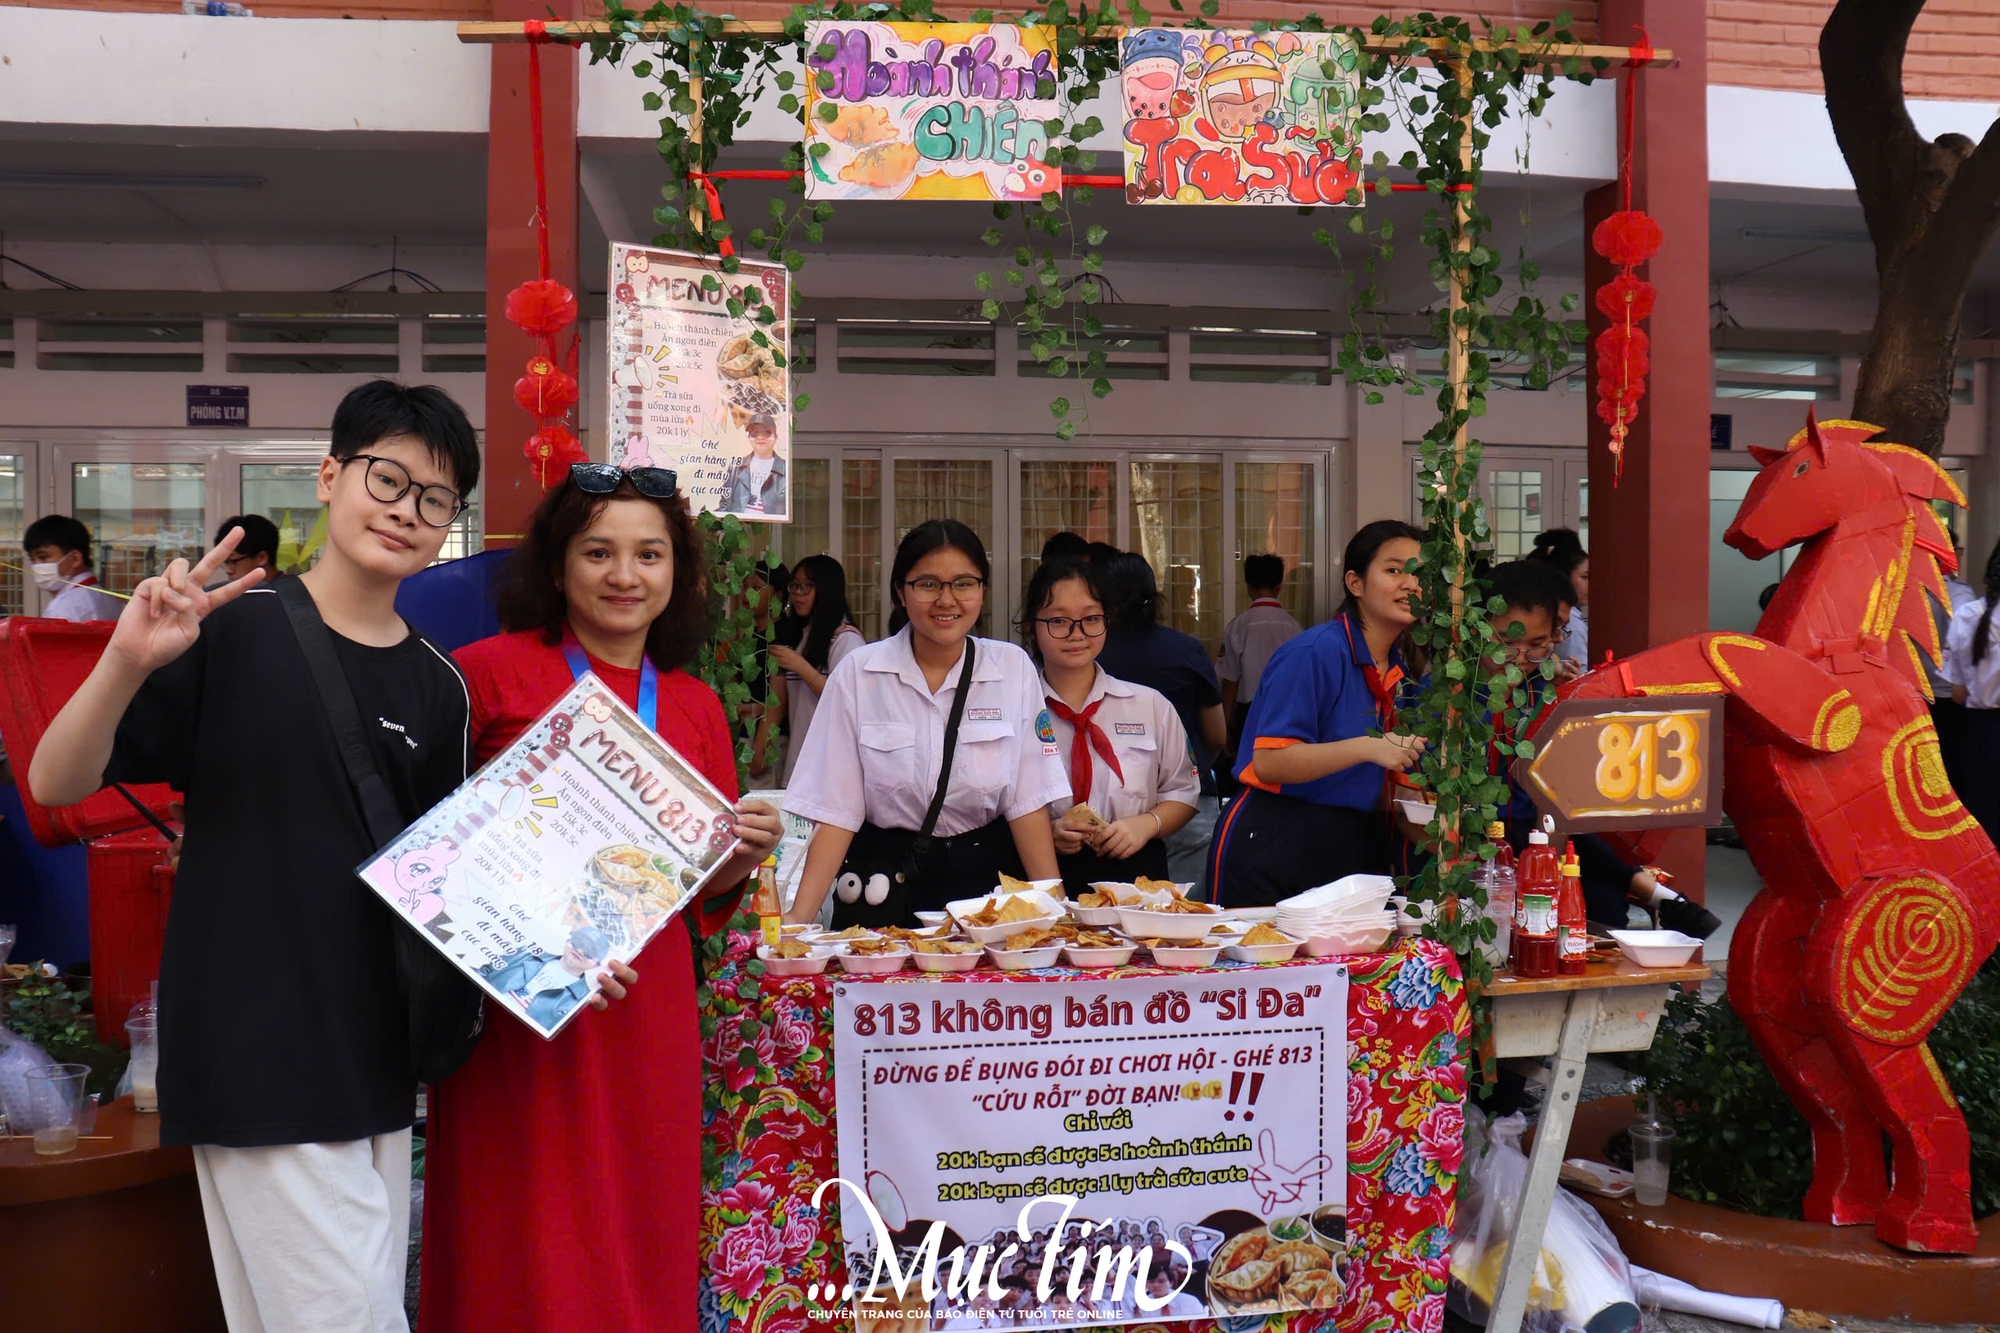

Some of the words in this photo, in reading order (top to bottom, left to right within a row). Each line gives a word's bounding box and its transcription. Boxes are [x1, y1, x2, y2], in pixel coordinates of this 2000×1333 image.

[809, 29, 952, 102] Hoành
[951, 37, 1057, 101] thánh
[1123, 117, 1246, 200] Trà
[646, 275, 724, 305] MENU
[675, 337, 698, 347] ngon
[684, 323, 710, 335] thánh
[711, 327, 734, 337] chiên
[694, 361, 703, 370] 5c
[647, 401, 669, 412] uống
[670, 403, 691, 413] xong
[693, 403, 701, 413] đi
[663, 390, 677, 399] Trà
[679, 391, 693, 400] sữa
[650, 414, 670, 423] múa
[656, 426, 673, 435] 20k
[680, 428, 688, 437] ly
[679, 455, 701, 465] gian
[705, 455, 727, 466] hàng
[731, 456, 743, 466] 18
[694, 469, 704, 479] đi
[691, 485, 706, 496] cục
[710, 486, 731, 497] cưng
[1595, 714, 1702, 803] 813
[579, 729, 669, 806] MENU
[657, 799, 707, 844] 813
[556, 786, 571, 802] Ăn
[570, 799, 593, 822] ngon
[592, 819, 613, 840] điên
[561, 770, 590, 800] Hoành
[589, 797, 616, 823] thánh
[614, 819, 640, 845] chiên
[549, 819, 568, 838] 20k
[567, 834, 579, 847] 5c
[562, 811, 578, 827] 15k
[576, 823, 588, 836] 3c
[474, 854, 493, 873] 20k
[497, 875, 508, 886] ly
[507, 850, 531, 872] xong
[461, 930, 481, 945] cục
[472, 896, 500, 919] gian
[500, 918, 527, 943] hàng
[527, 942, 544, 955] 18
[476, 921, 492, 931] đi
[854, 1003, 921, 1036] 813
[932, 998, 1052, 1038] không
[1064, 994, 1133, 1028] bán
[1144, 990, 1191, 1024] đồ
[873, 1061, 938, 1085] ĐỪNG
[944, 1056, 975, 1082] ĐỂ
[978, 1061, 1038, 1085] BỤNG
[1044, 1054, 1085, 1077] ĐÓI
[1090, 1057, 1113, 1075] ĐI
[1118, 1053, 1172, 1074] CHƠI
[1177, 1048, 1216, 1074] HỘI
[1233, 1044, 1274, 1067] GHÉ
[1278, 1046, 1313, 1064] 813
[1086, 1084, 1126, 1106] ĐỜI
[1131, 1085, 1181, 1107] BẠN!
[1063, 1110, 1098, 1132] Chỉ
[1100, 1107, 1132, 1132] với
[937, 1151, 977, 1170] 20k
[978, 1150, 1022, 1173] bạn
[1023, 1145, 1046, 1166] sẽ
[1099, 1144, 1121, 1162] 5c
[1122, 1136, 1189, 1161] hoành
[1190, 1132, 1252, 1155] thánh
[938, 1182, 978, 1202] 20k
[979, 1181, 1022, 1203] bạn
[1024, 1176, 1047, 1197] sẽ
[1099, 1174, 1110, 1192] 1
[1112, 1173, 1134, 1195] ly
[1135, 1166, 1168, 1189] trà
[1169, 1166, 1205, 1187] sữa
[1207, 1165, 1249, 1184] cute
